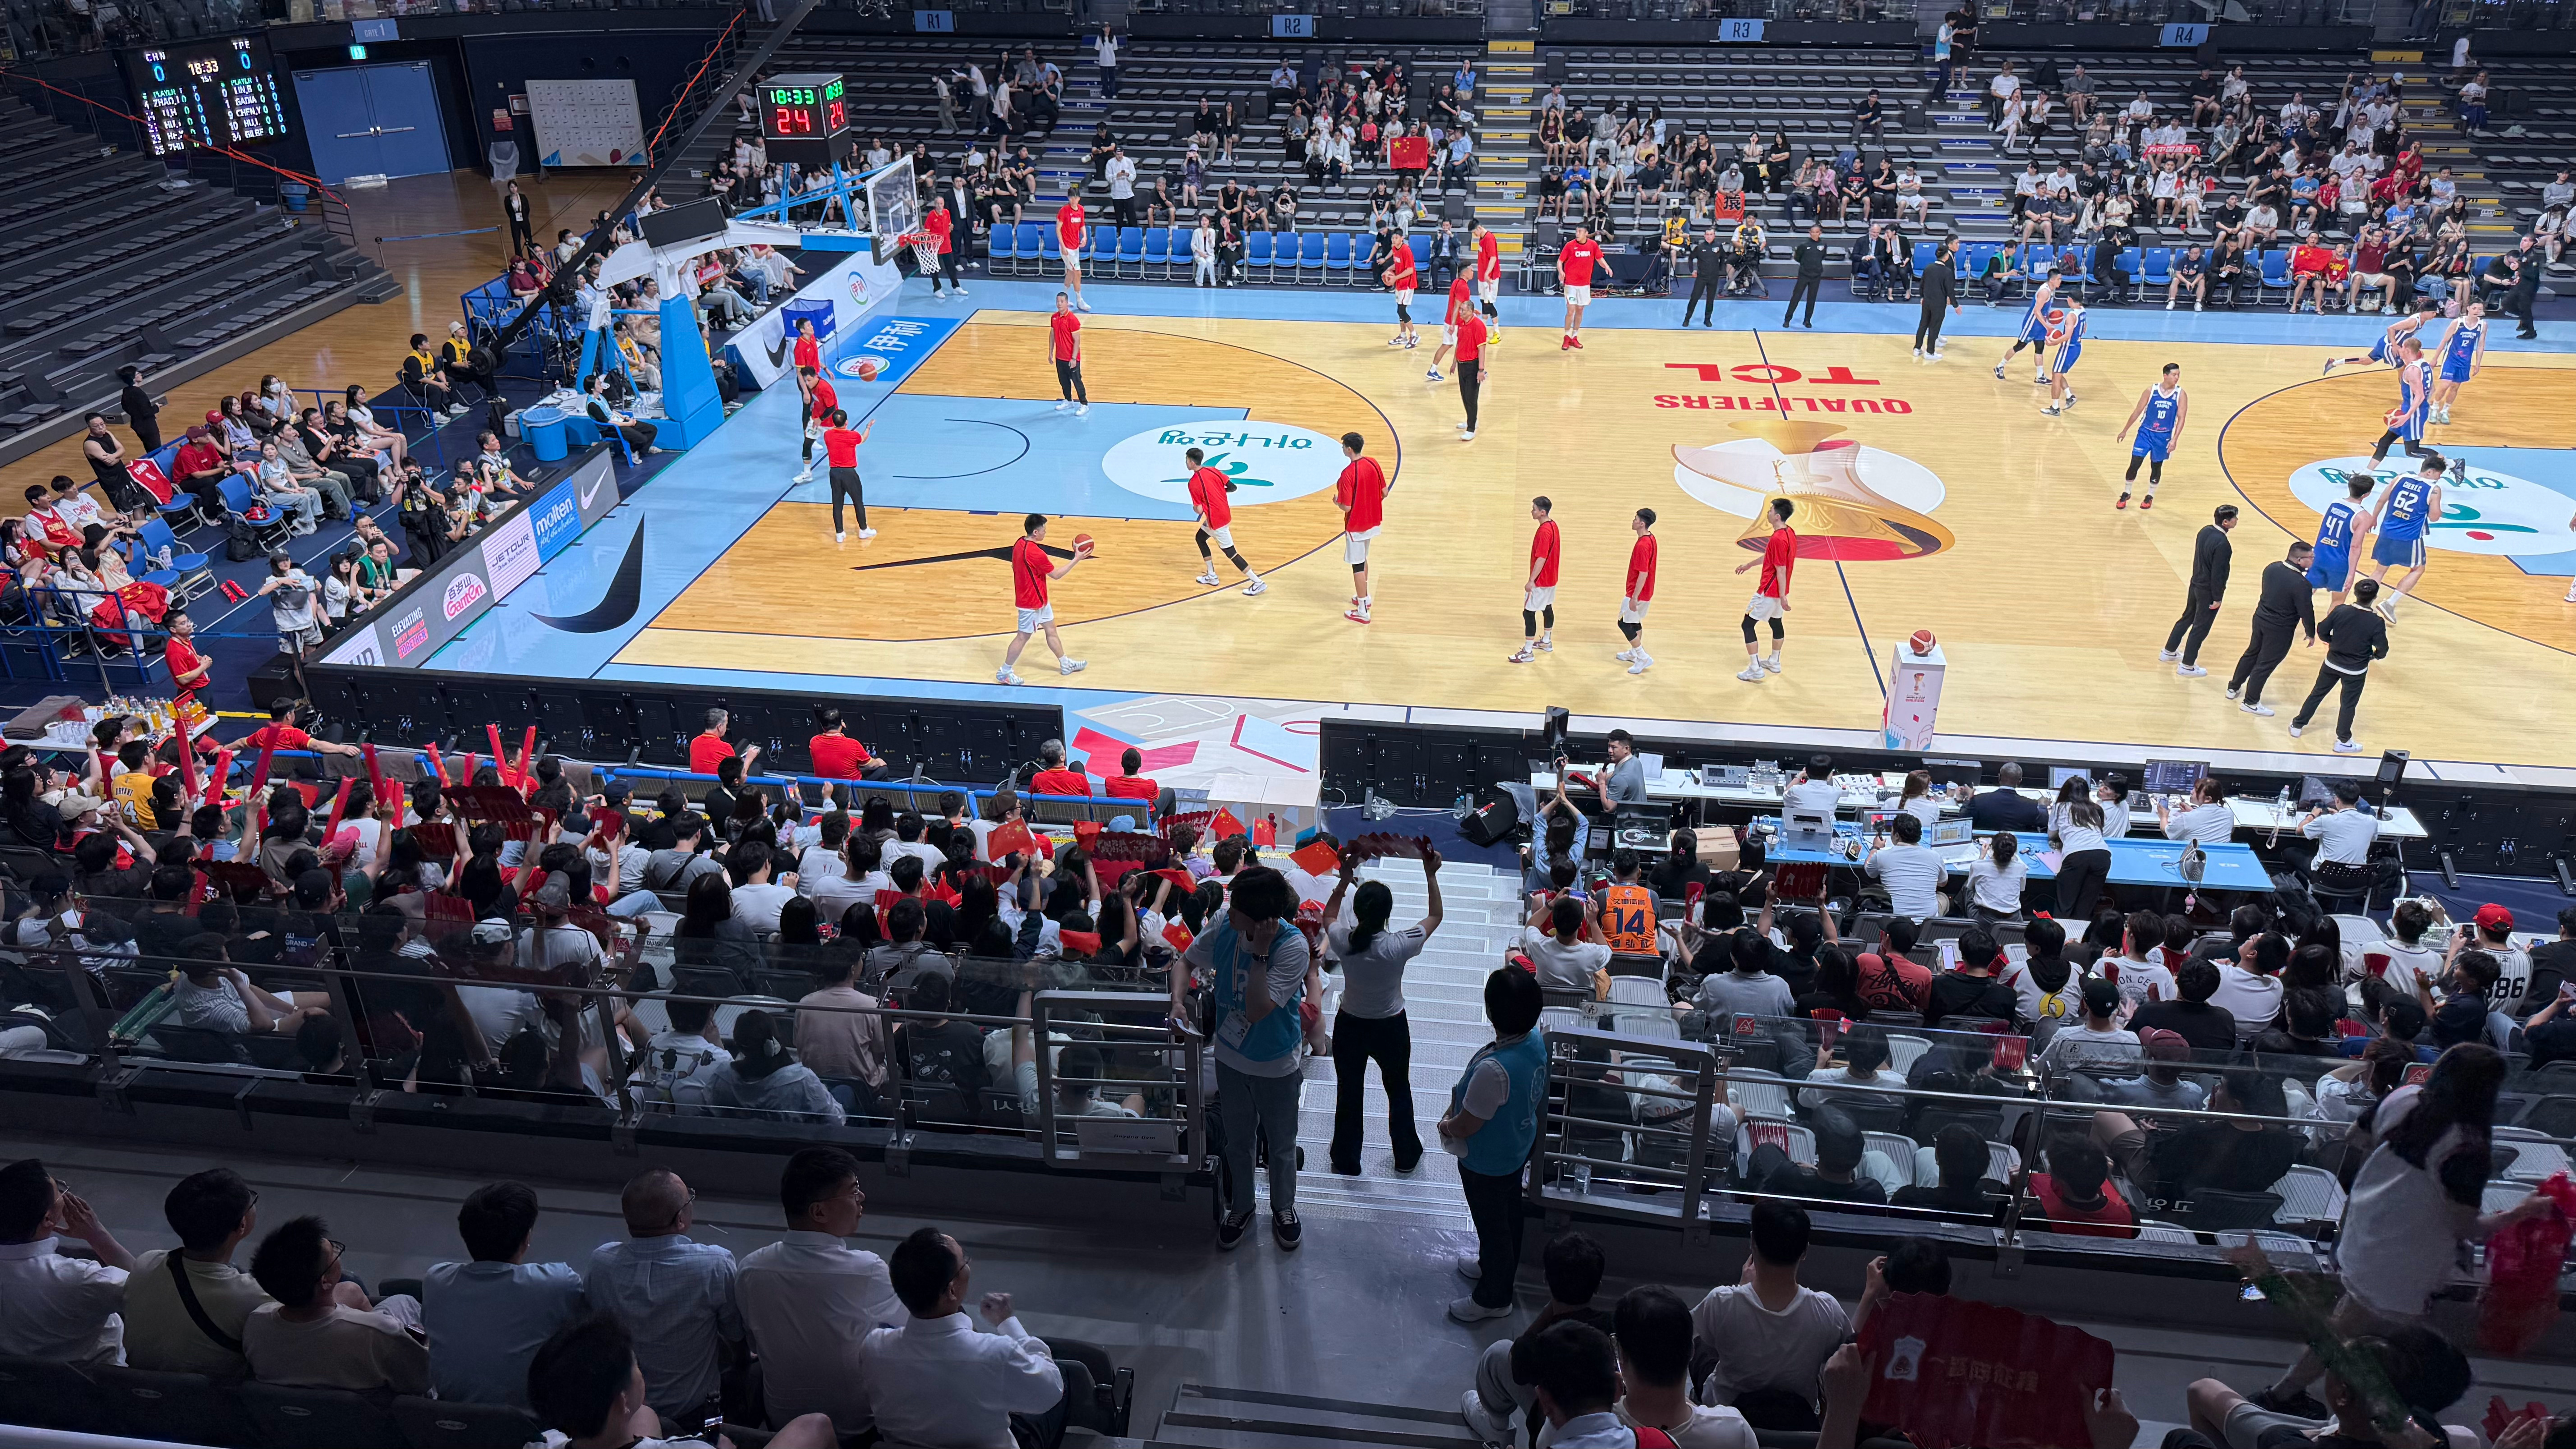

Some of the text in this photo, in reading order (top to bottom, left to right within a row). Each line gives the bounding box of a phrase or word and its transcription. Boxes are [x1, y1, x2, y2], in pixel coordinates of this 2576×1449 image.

[927, 14, 940, 28] R1
[1285, 18, 1300, 34] R2
[364, 23, 385, 37] GATE 1
[1733, 22, 1750, 38] R3
[2175, 27, 2194, 43] R4
[233, 41, 250, 50] TPE
[145, 51, 166, 62] CHN
[241, 54, 251, 69] 0
[154, 66, 165, 81] 0
[188, 60, 219, 75] 18:33
[230, 77, 252, 86] PLAYER
[257, 83, 262, 92] 0
[270, 81, 275, 90] 0
[194, 93, 200, 102] 0
[260, 94, 265, 103] 0
[272, 92, 277, 101] 0
[770, 90, 814, 105] 18:33
[826, 81, 844, 101] 18:33
[184, 106, 190, 114] 0
[197, 104, 203, 113] 0
[228, 110, 233, 120] 9
[263, 105, 268, 114] 0
[275, 103, 281, 112] 0
[830, 101, 844, 129] 24
[187, 117, 193, 125] 0
[200, 115, 206, 124] 0
[229, 122, 239, 130] 10
[266, 116, 271, 124] 0
[278, 114, 283, 123] 0
[777, 109, 810, 133] 24
[203, 126, 209, 135] 0
[268, 126, 274, 135] 0
[281, 124, 286, 133] 0
[207, 137, 212, 146] 0
[863, 320, 930, 352] 伊利
[1664, 363, 1881, 385] TCL
[1654, 395, 1912, 414] QUALIFIERS
[2157, 410, 2166, 419] 10
[1158, 430, 1312, 449] 하나은행
[135, 462, 149, 475] CHINA
[73, 501, 95, 516] CHINA
[2393, 490, 2418, 512] 62
[536, 497, 573, 536] molten
[47, 522, 65, 533] CHINA
[2326, 515, 2344, 538] 41
[492, 533, 529, 568] JETOUR
[448, 575, 471, 600] 百岁山
[391, 606, 423, 637] ELEVATING
[1612, 907, 1646, 936] 14
[2039, 989, 2065, 1019] 6
